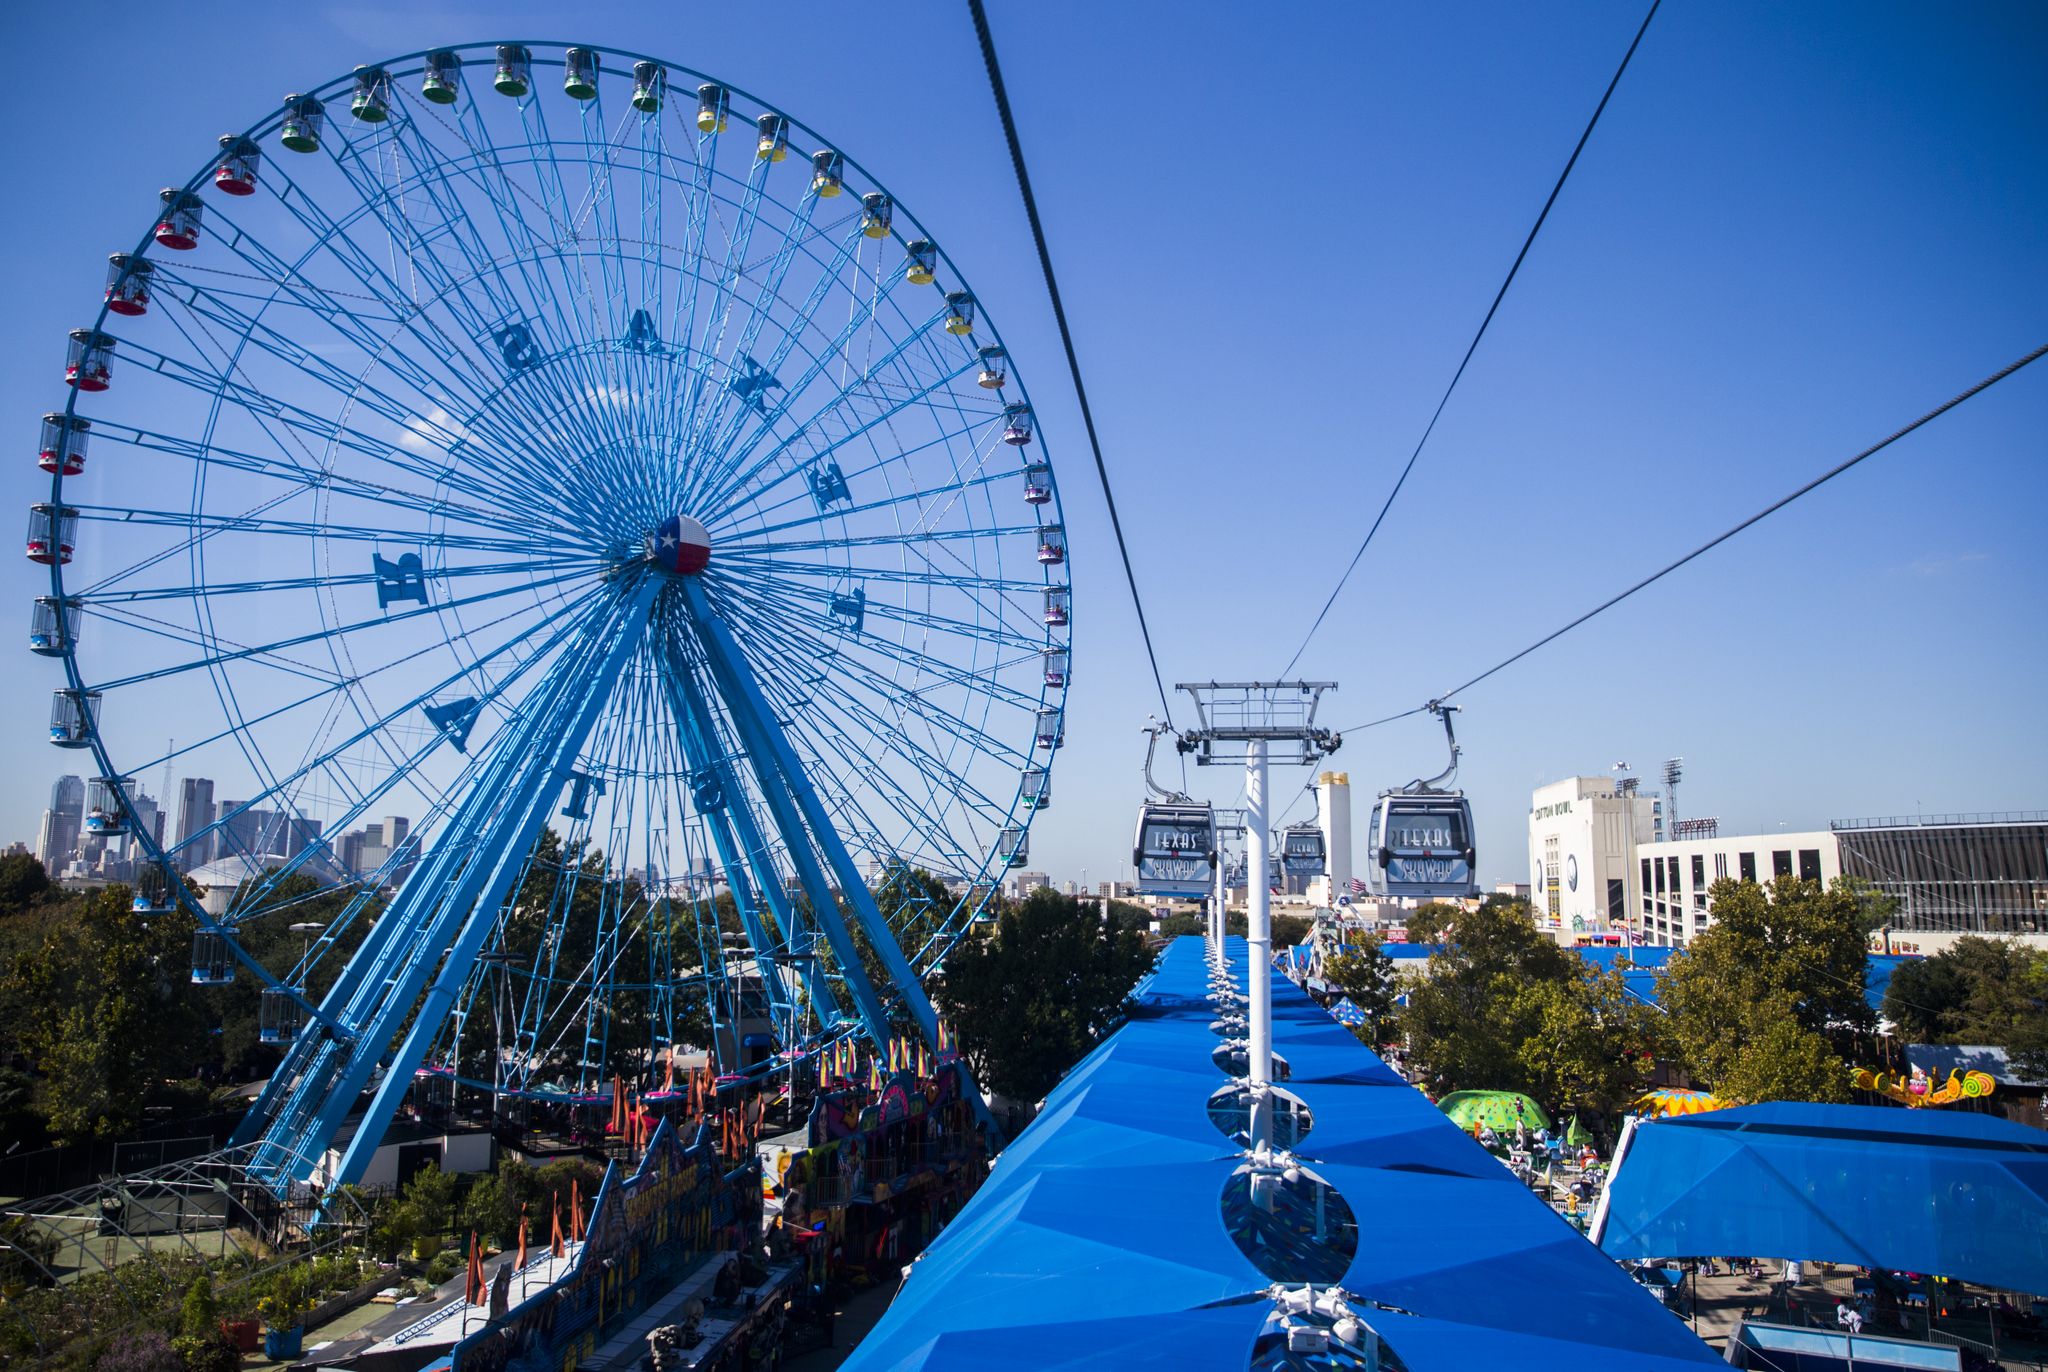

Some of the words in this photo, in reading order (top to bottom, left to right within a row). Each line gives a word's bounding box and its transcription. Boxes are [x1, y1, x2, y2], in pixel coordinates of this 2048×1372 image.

[1555, 800, 1573, 816] BOWL
[1154, 832, 1197, 849] TEXAS
[1402, 828, 1452, 847] TEXAS
[1292, 843, 1316, 853] TEXAS
[1153, 858, 1198, 876] SKYWAY
[1402, 859, 1453, 880] SKYWAY
